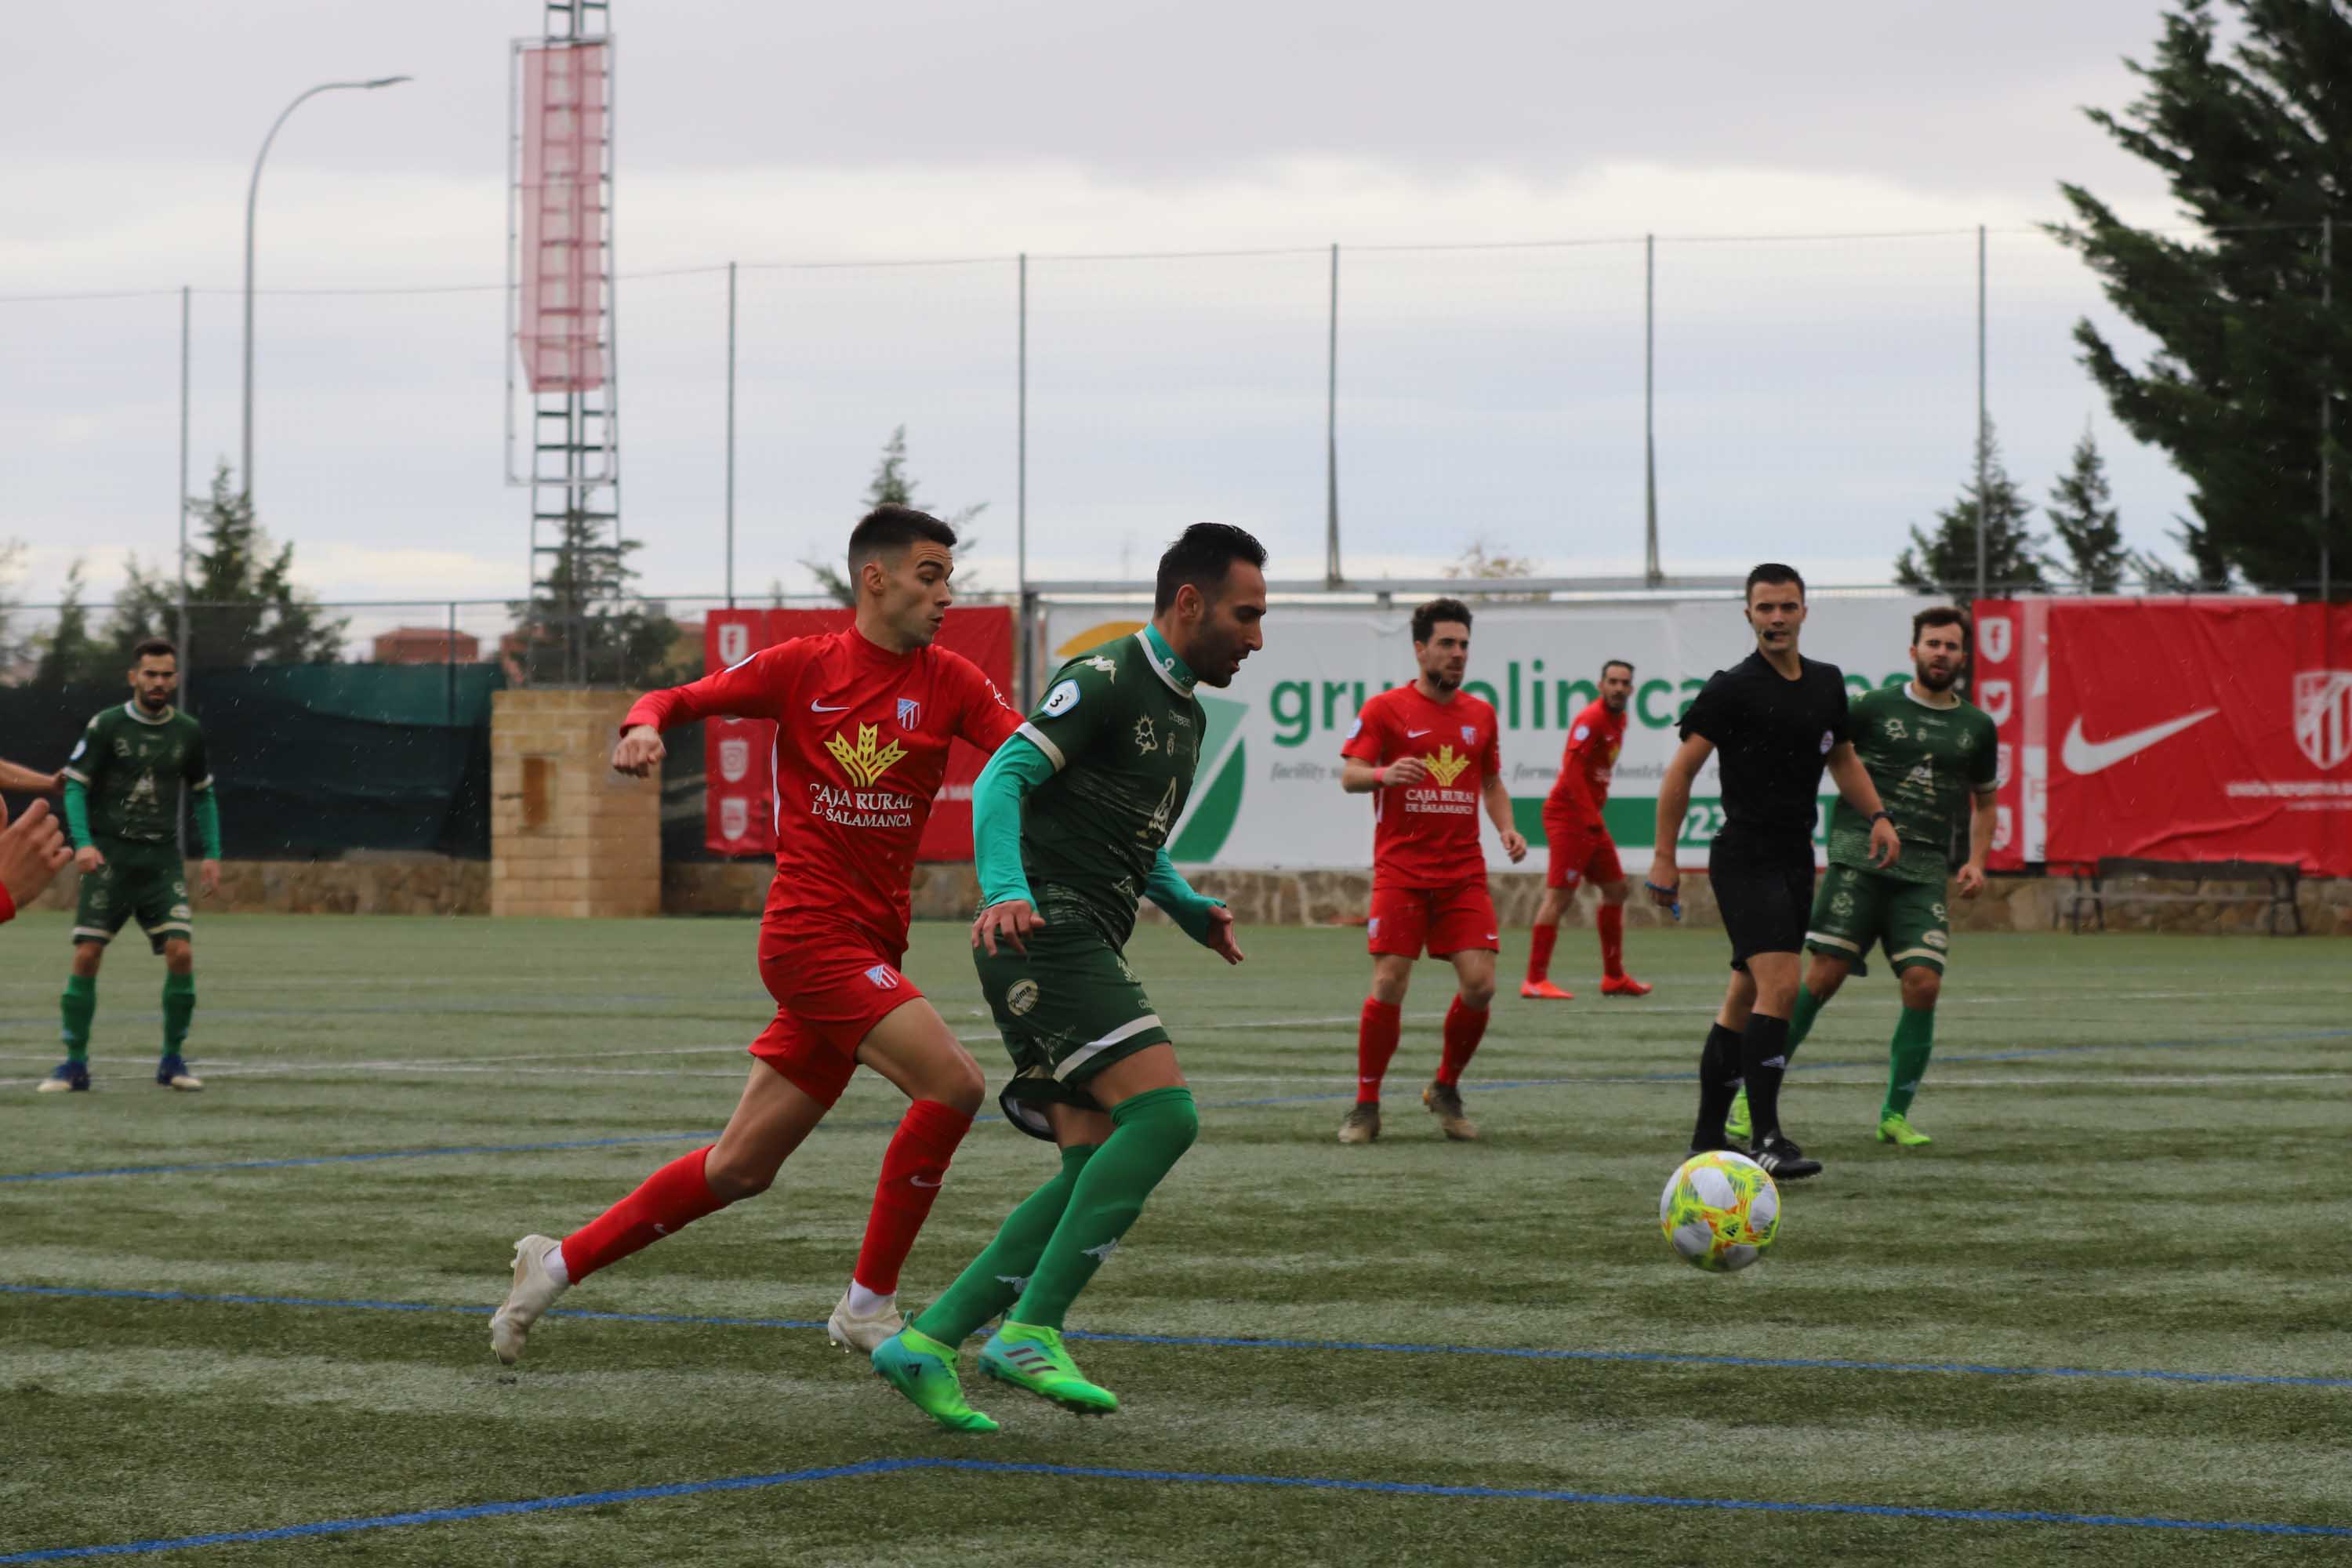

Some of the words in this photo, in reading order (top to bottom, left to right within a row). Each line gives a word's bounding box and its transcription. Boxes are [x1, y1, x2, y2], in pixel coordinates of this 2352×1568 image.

[1049, 693, 1064, 708] 3
[810, 783, 852, 808] CAJA
[855, 793, 913, 810] RURAL
[811, 801, 825, 815] D
[826, 808, 911, 827] SALAMANCA
